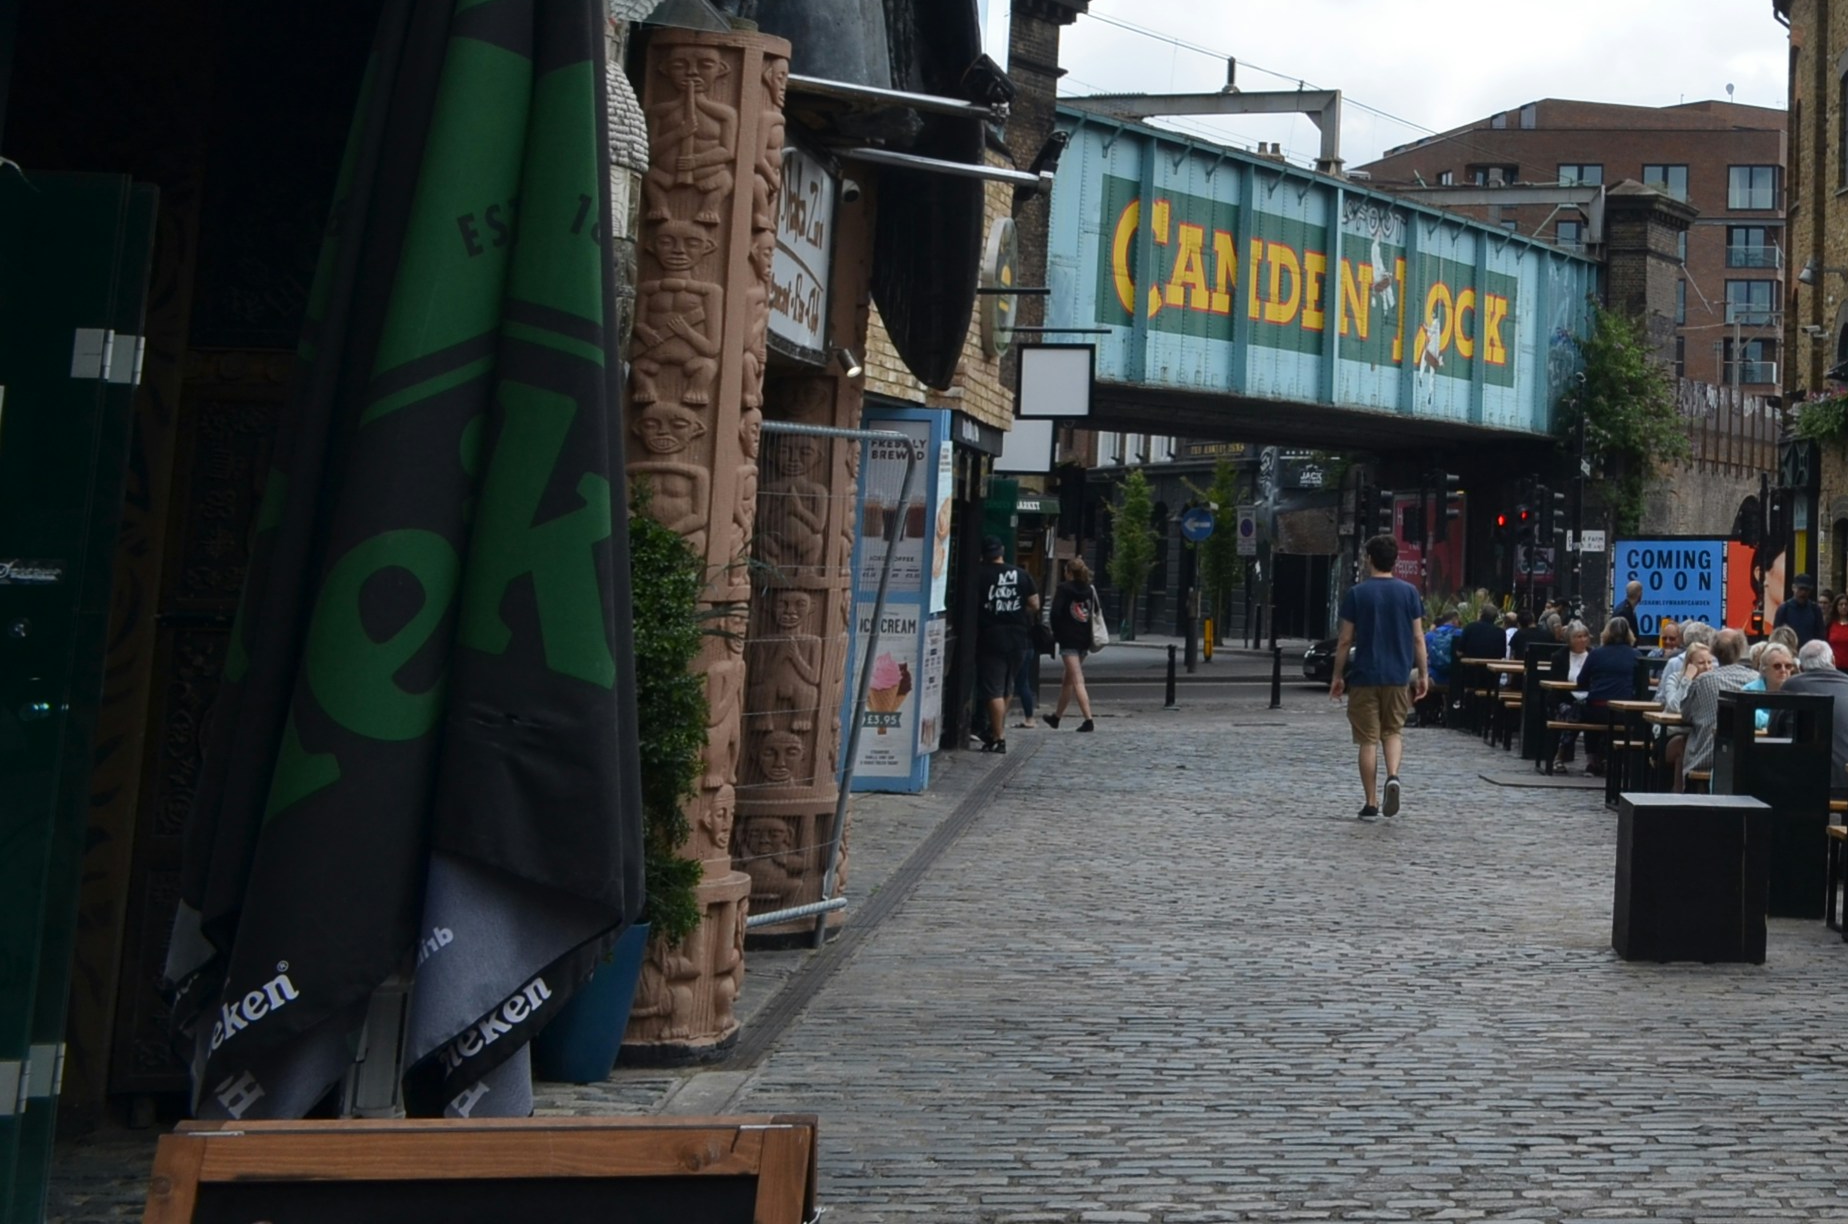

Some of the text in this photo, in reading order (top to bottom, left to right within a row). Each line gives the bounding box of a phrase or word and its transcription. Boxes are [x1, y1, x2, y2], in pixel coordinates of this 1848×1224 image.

[1111, 198, 1509, 366] CAMDEN LOCK
[871, 450, 926, 460] BREWD
[1626, 550, 1711, 570] COMING
[881, 618, 917, 634] CREAM
[867, 716, 898, 726] £3.95
